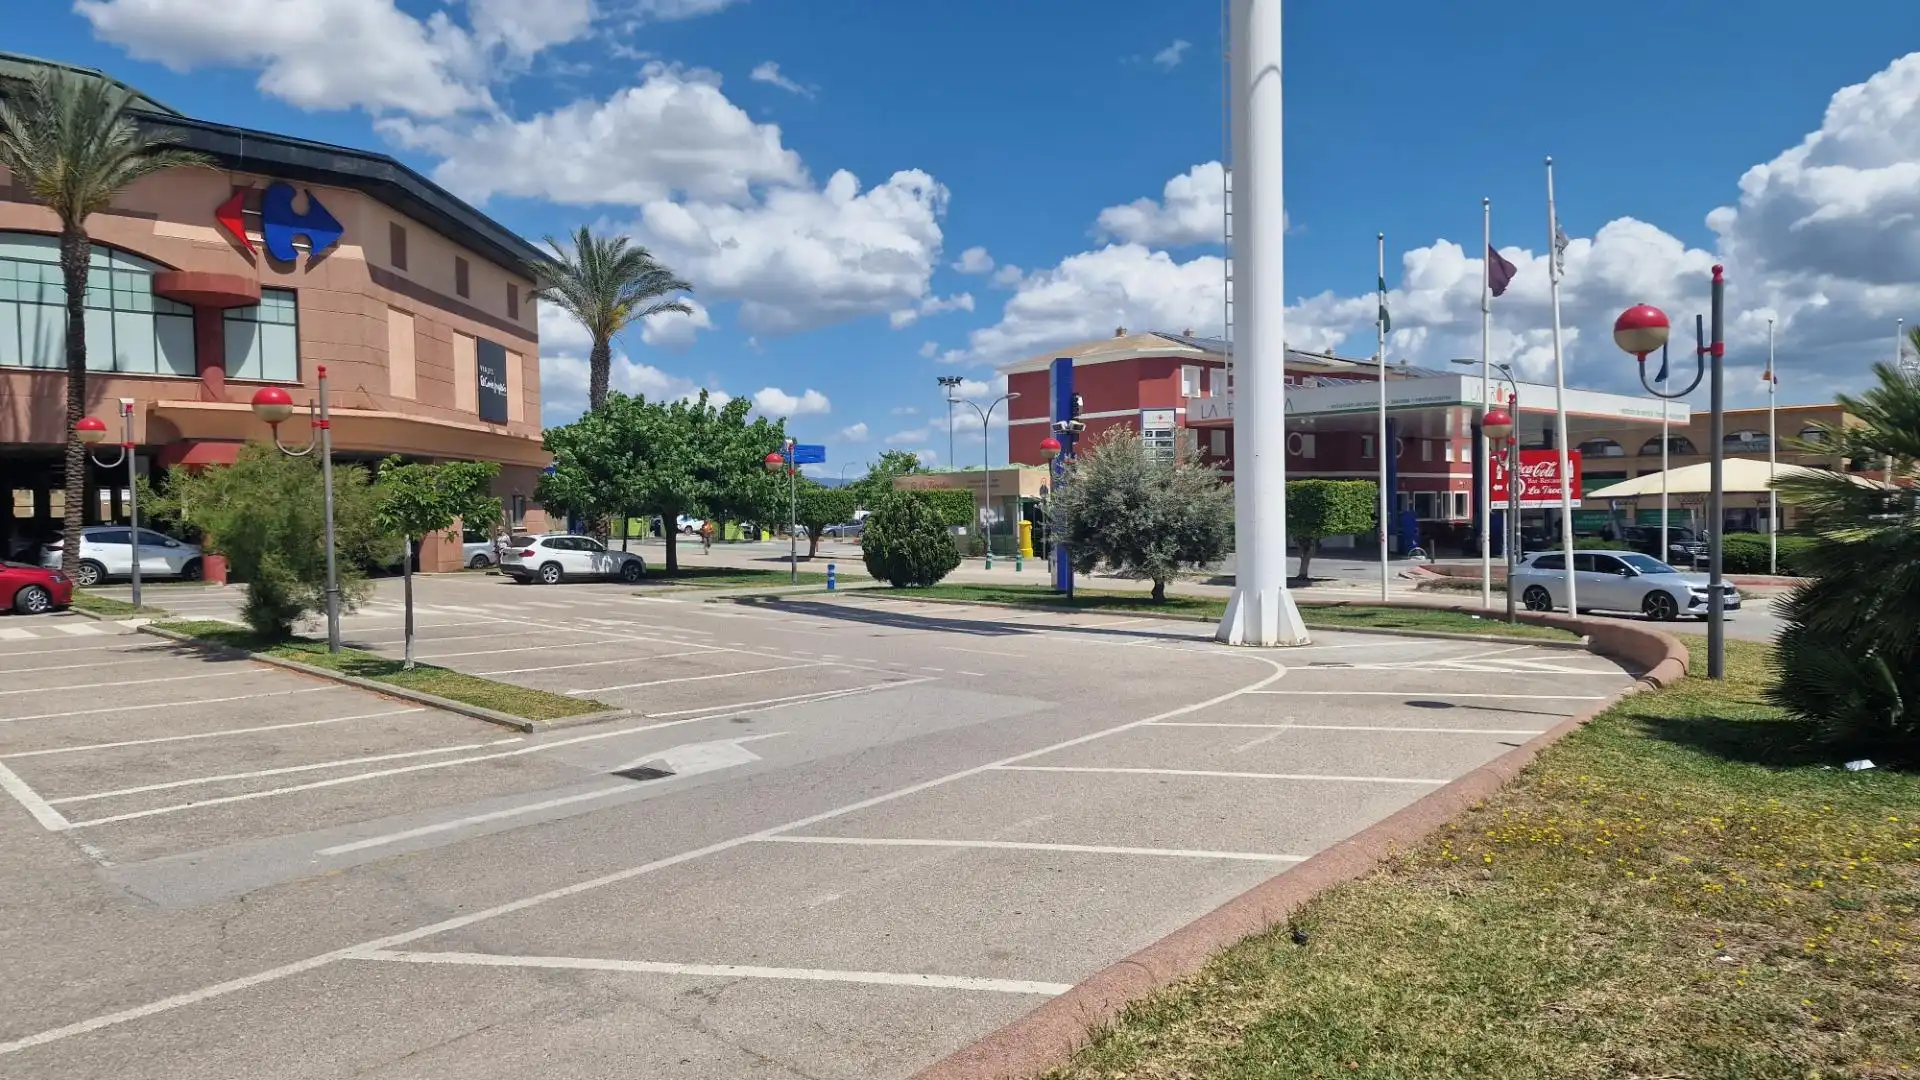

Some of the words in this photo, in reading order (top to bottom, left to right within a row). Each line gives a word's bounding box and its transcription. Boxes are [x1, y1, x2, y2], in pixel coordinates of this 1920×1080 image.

[1201, 404, 1218, 420] LA
[1505, 461, 1557, 477] ca-Cola
[1527, 485, 1540, 495] La
[1541, 485, 1574, 495] Troc
